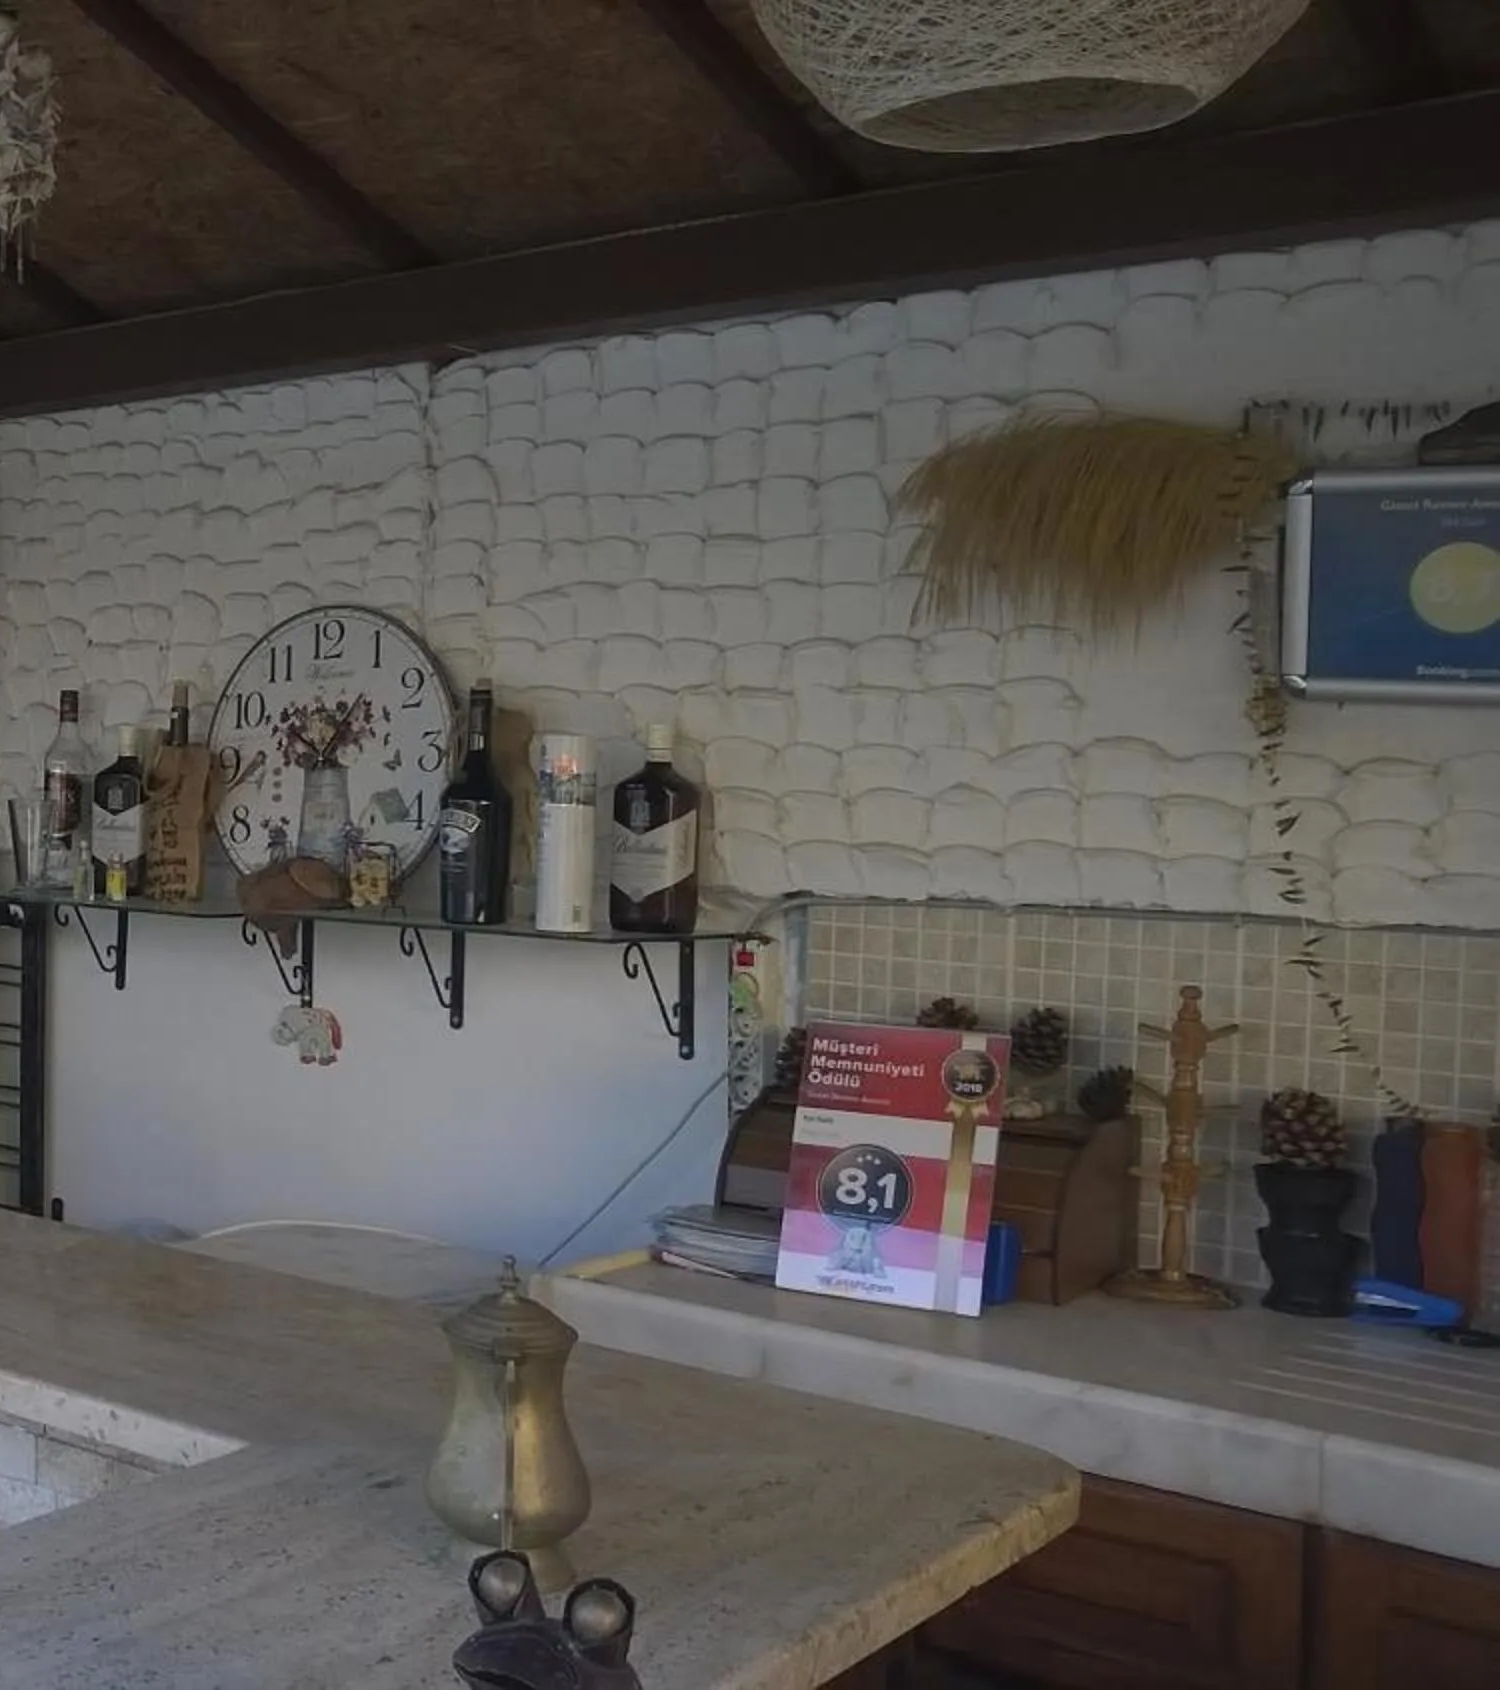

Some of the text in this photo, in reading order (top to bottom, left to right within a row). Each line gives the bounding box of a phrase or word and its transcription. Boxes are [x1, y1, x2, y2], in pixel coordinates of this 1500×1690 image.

[312, 619, 345, 660] 12
[371, 629, 382, 668] 1
[268, 644, 293, 684] 11
[400, 667, 425, 709] 2
[235, 691, 266, 730] 10
[218, 745, 241, 785] 9
[417, 729, 444, 773] 3
[229, 804, 251, 845] 8
[403, 789, 424, 831] 4
[810, 1054, 926, 1079] Memnuniyeti
[812, 1037, 880, 1057] Müşteri
[807, 1067, 861, 1089] Ödülü
[835, 1167, 898, 1214] 8,1
